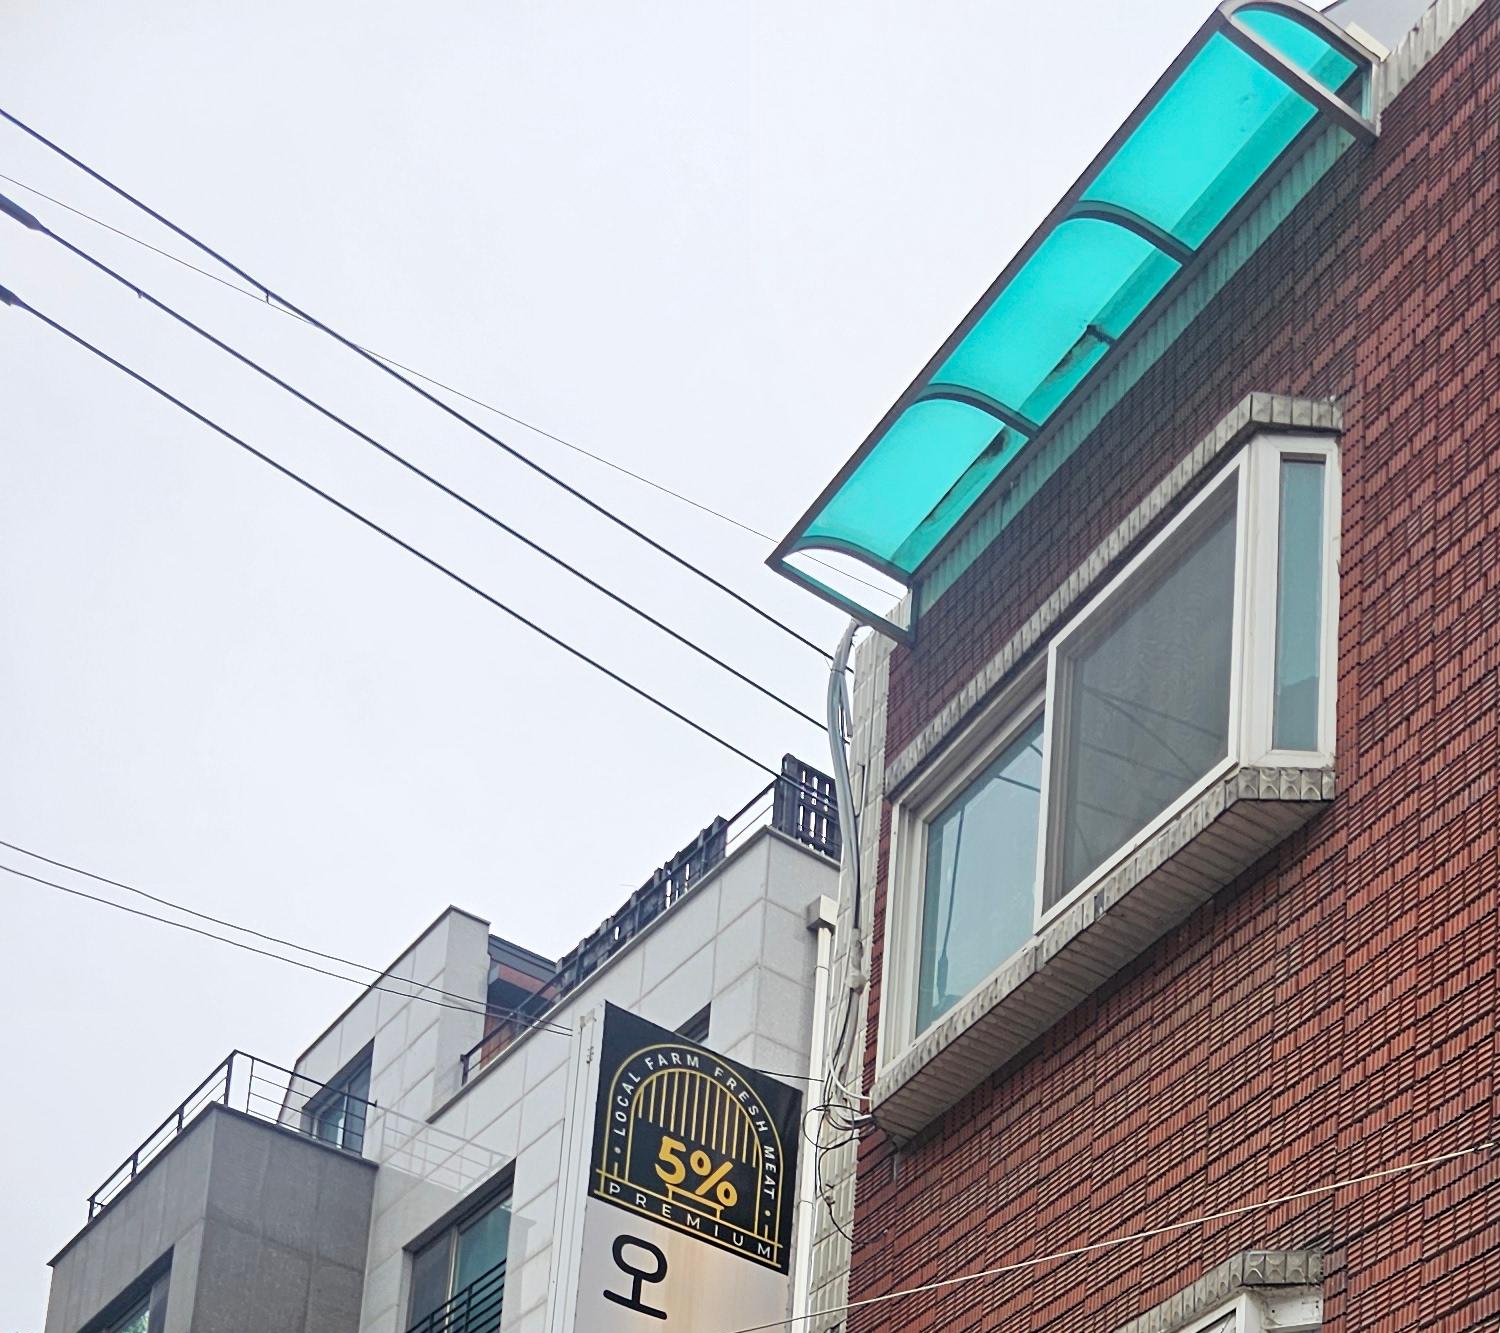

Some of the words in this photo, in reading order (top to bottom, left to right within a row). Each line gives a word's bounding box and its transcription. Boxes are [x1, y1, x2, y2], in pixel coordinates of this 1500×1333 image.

[613, 1072, 641, 1137] LOCAL
[645, 1052, 700, 1071] FARM
[714, 1066, 769, 1132] FRESH
[763, 1145, 776, 1200] MEAT
[655, 1135, 738, 1208] 5%
[608, 1181, 772, 1259] PREMIUM
